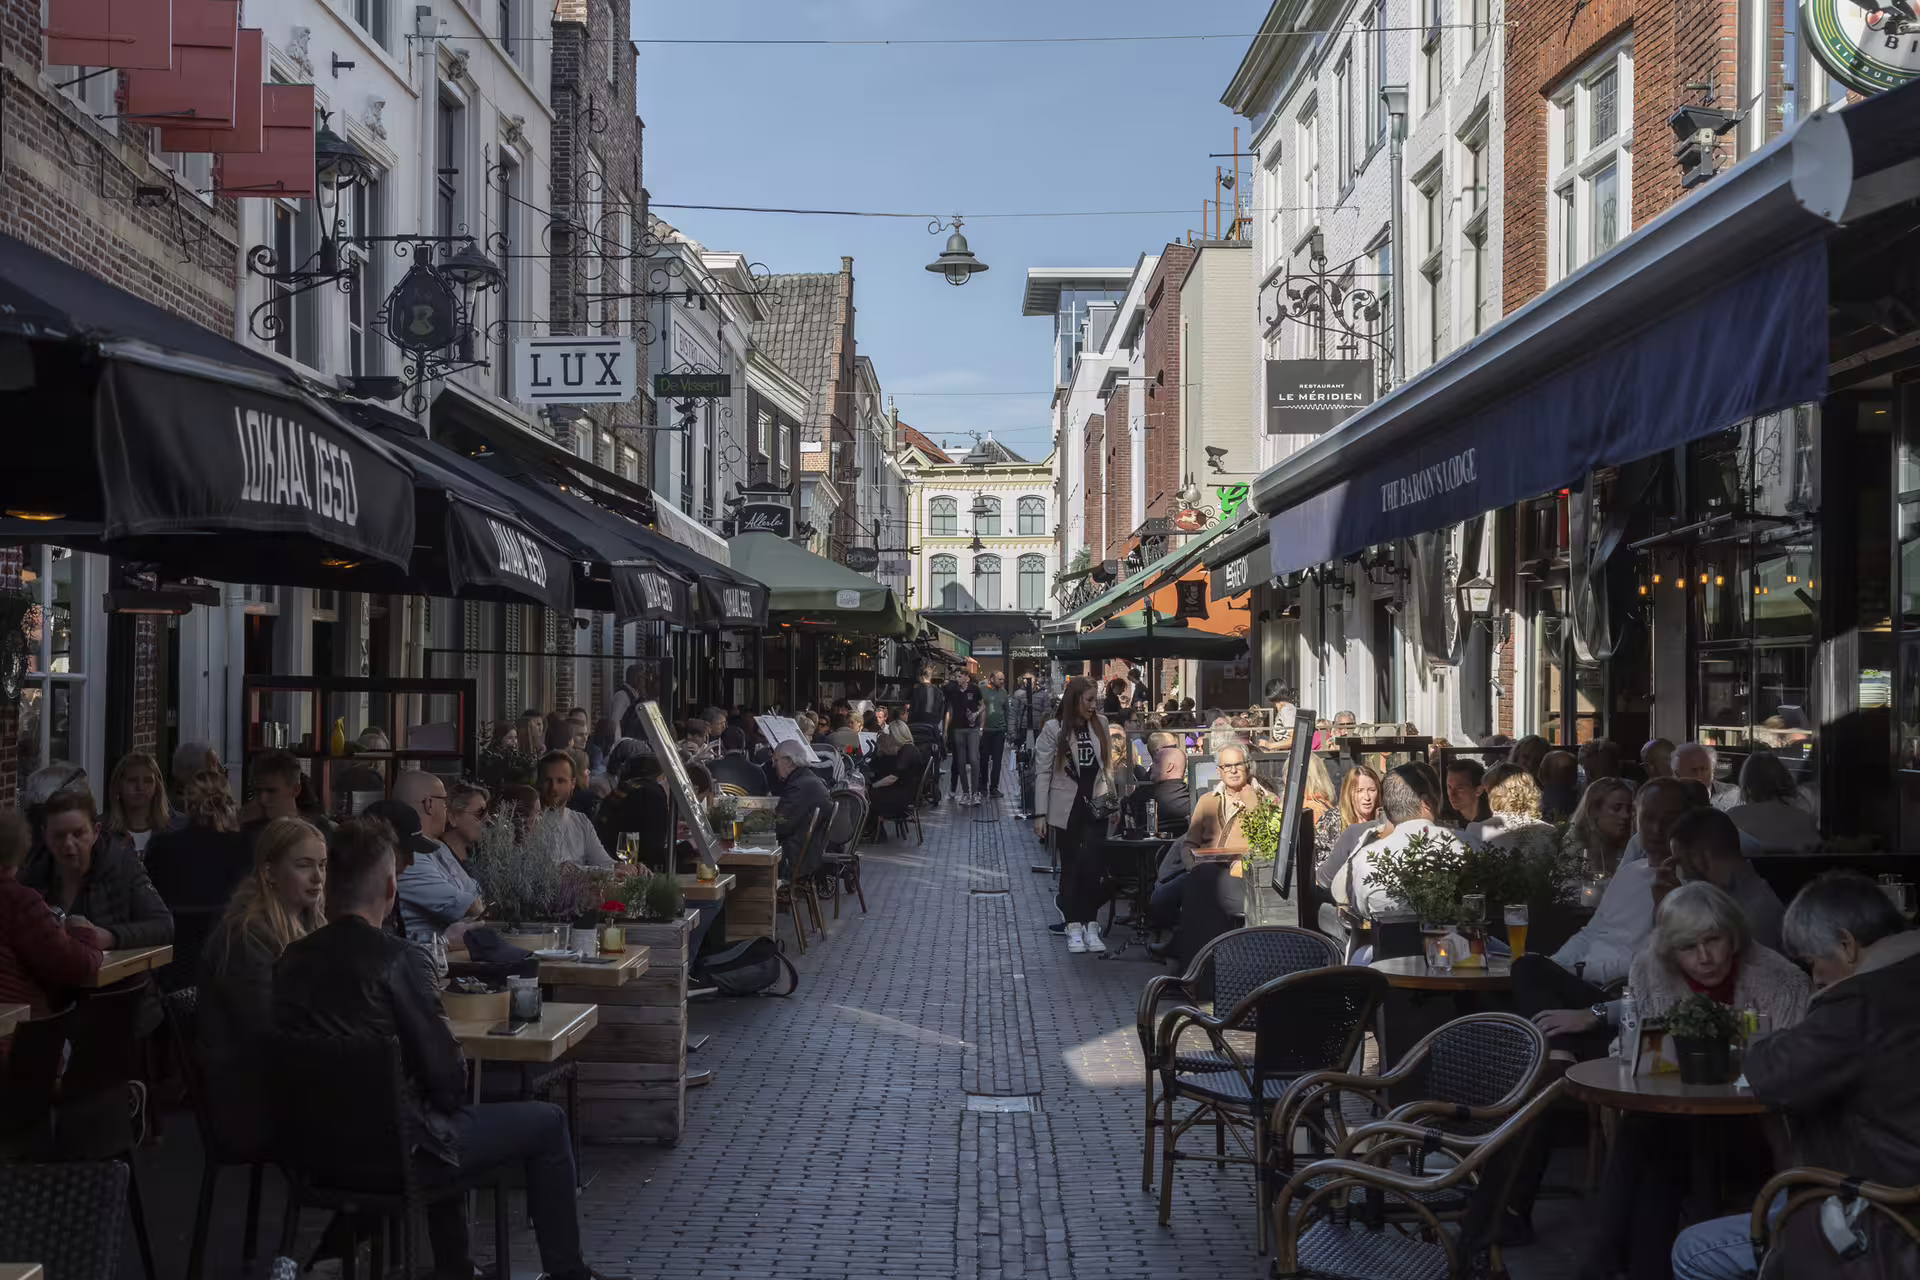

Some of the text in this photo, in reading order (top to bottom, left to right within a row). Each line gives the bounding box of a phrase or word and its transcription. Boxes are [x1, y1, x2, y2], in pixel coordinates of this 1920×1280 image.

[530, 352, 622, 387] LUX
[660, 377, 677, 392] De
[1278, 390, 1362, 401] LE MÉRIDIEN
[234, 405, 359, 526] LOKAAL 1650
[1381, 447, 1477, 513] THE BARON'S LODGE
[744, 511, 784, 529] Allerlei
